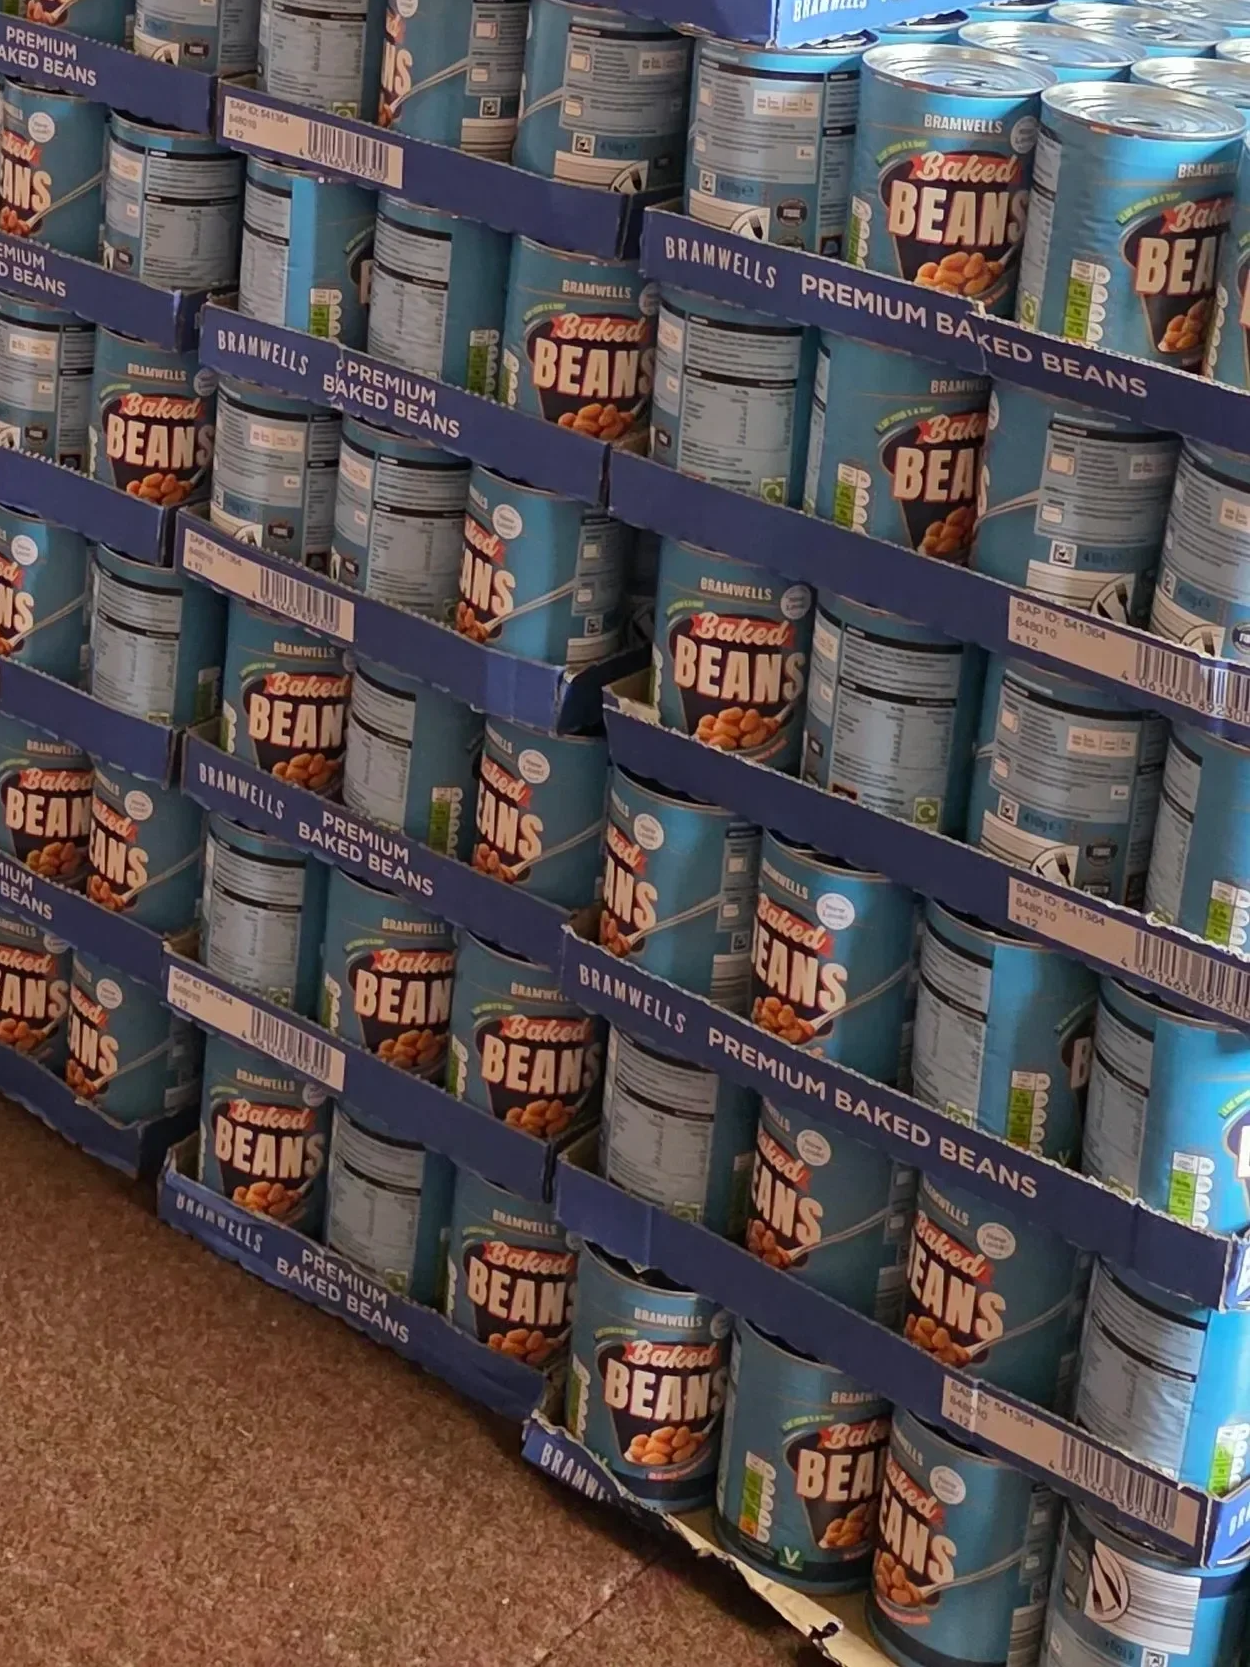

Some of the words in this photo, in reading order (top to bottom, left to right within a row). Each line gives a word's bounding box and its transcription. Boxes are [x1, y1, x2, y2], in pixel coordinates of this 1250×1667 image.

[5, 25, 77, 60] PREMIUM
[43, 57, 97, 87] BEANS
[924, 113, 1004, 134] BRAMWELLS
[916, 151, 1018, 184] Baked
[888, 187, 1029, 246] BEANS
[665, 236, 777, 290] BRAMWELLS
[800, 272, 928, 330] PREMIUM
[934, 314, 1034, 364] BAKED
[1040, 350, 1148, 400] BEANS
[699, 577, 773, 602] BRAMWELLS
[1016, 601, 1041, 617] SAP
[694, 612, 792, 644] Baked
[673, 634, 807, 705] BEANS
[198, 763, 286, 821] BRAMWELLS
[298, 821, 364, 862] BAKED
[368, 853, 435, 898] BEANS
[322, 810, 410, 864] PREMIUM
[235, 1069, 296, 1092] BRAMWELLS
[578, 963, 687, 1034] BRAMWELLS
[707, 1026, 826, 1103] PREMIUM
[834, 1086, 931, 1149] BAKED
[938, 1127, 1038, 1197] BEANS
[228, 1098, 307, 1130] Baked
[214, 1125, 324, 1179] BEANS
[175, 1193, 263, 1255] BRAMWELLS
[275, 1256, 344, 1304] BAKED
[346, 1293, 410, 1344] BEANS
[300, 1247, 387, 1311] PREMIUM
